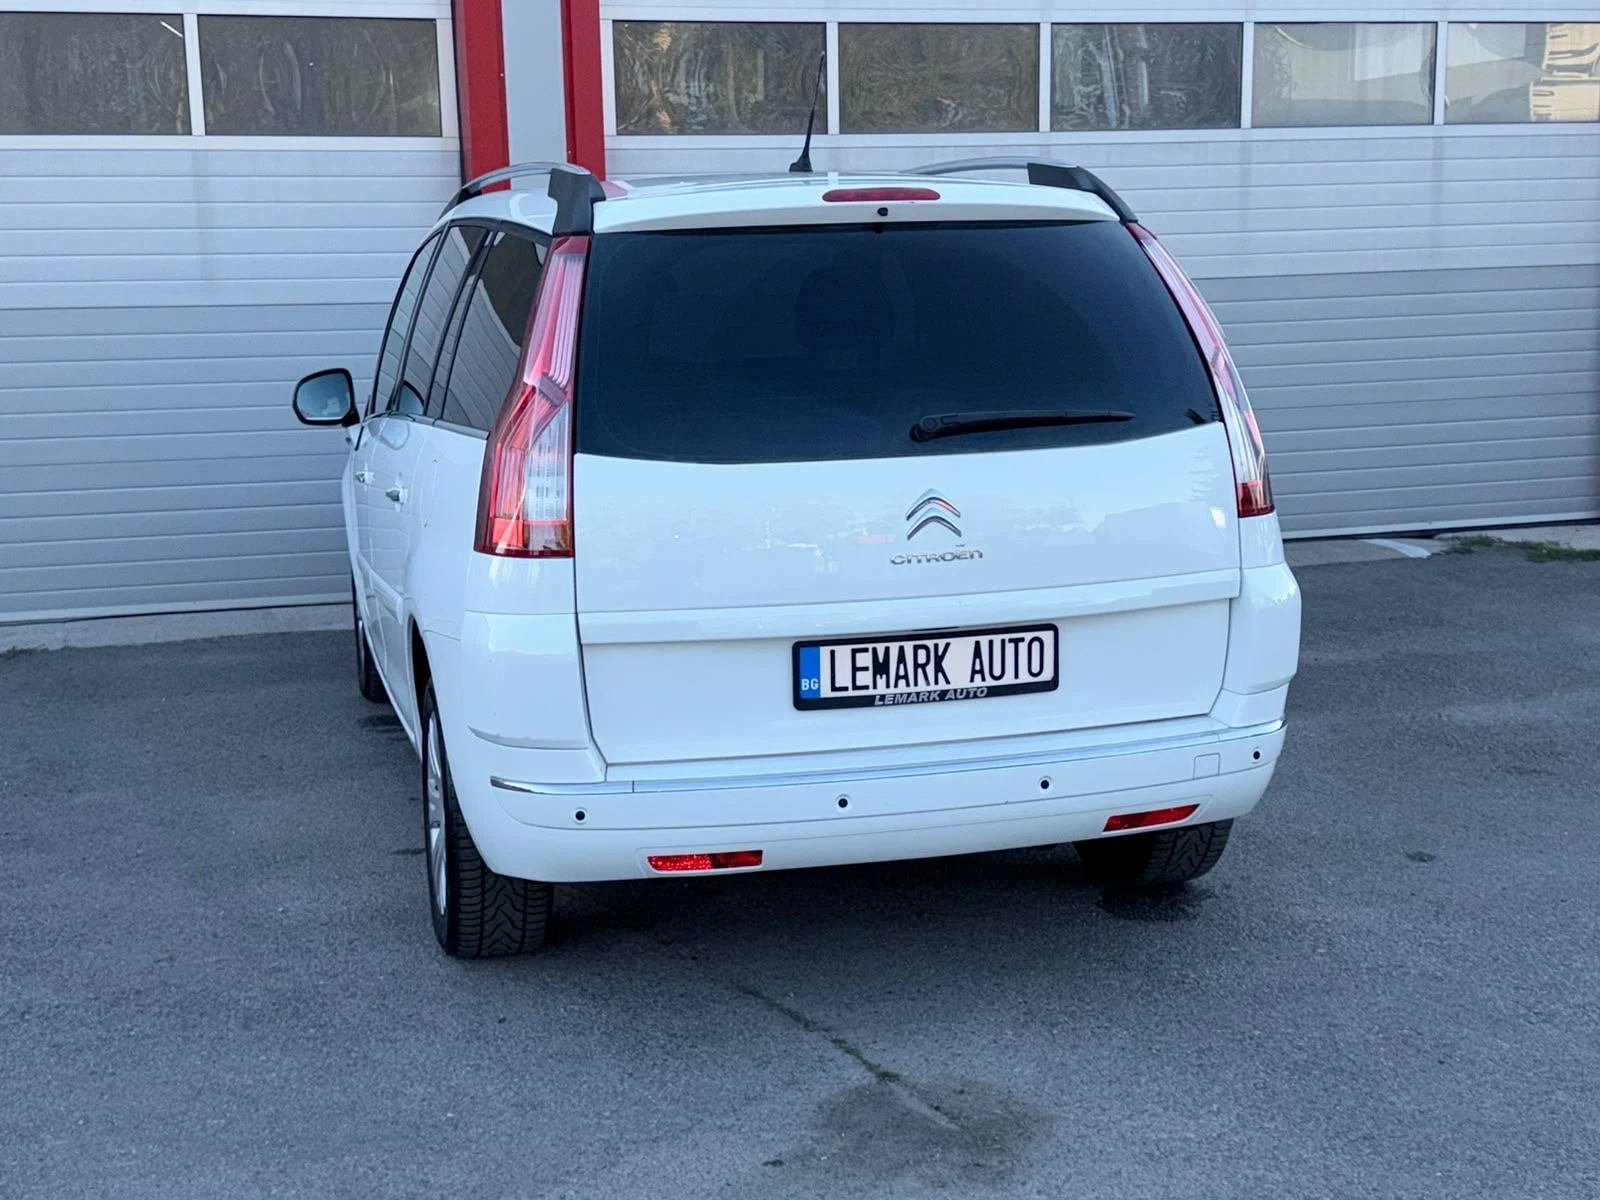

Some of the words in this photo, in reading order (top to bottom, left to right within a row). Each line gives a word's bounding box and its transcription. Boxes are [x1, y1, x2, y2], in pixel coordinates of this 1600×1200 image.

[890, 544, 983, 565] CITROËN
[830, 641, 951, 692] LEMARK
[969, 636, 1045, 683] AUTO
[801, 679, 819, 691] BG
[874, 691, 941, 706] LEMARK
[945, 687, 988, 701] AUTO
